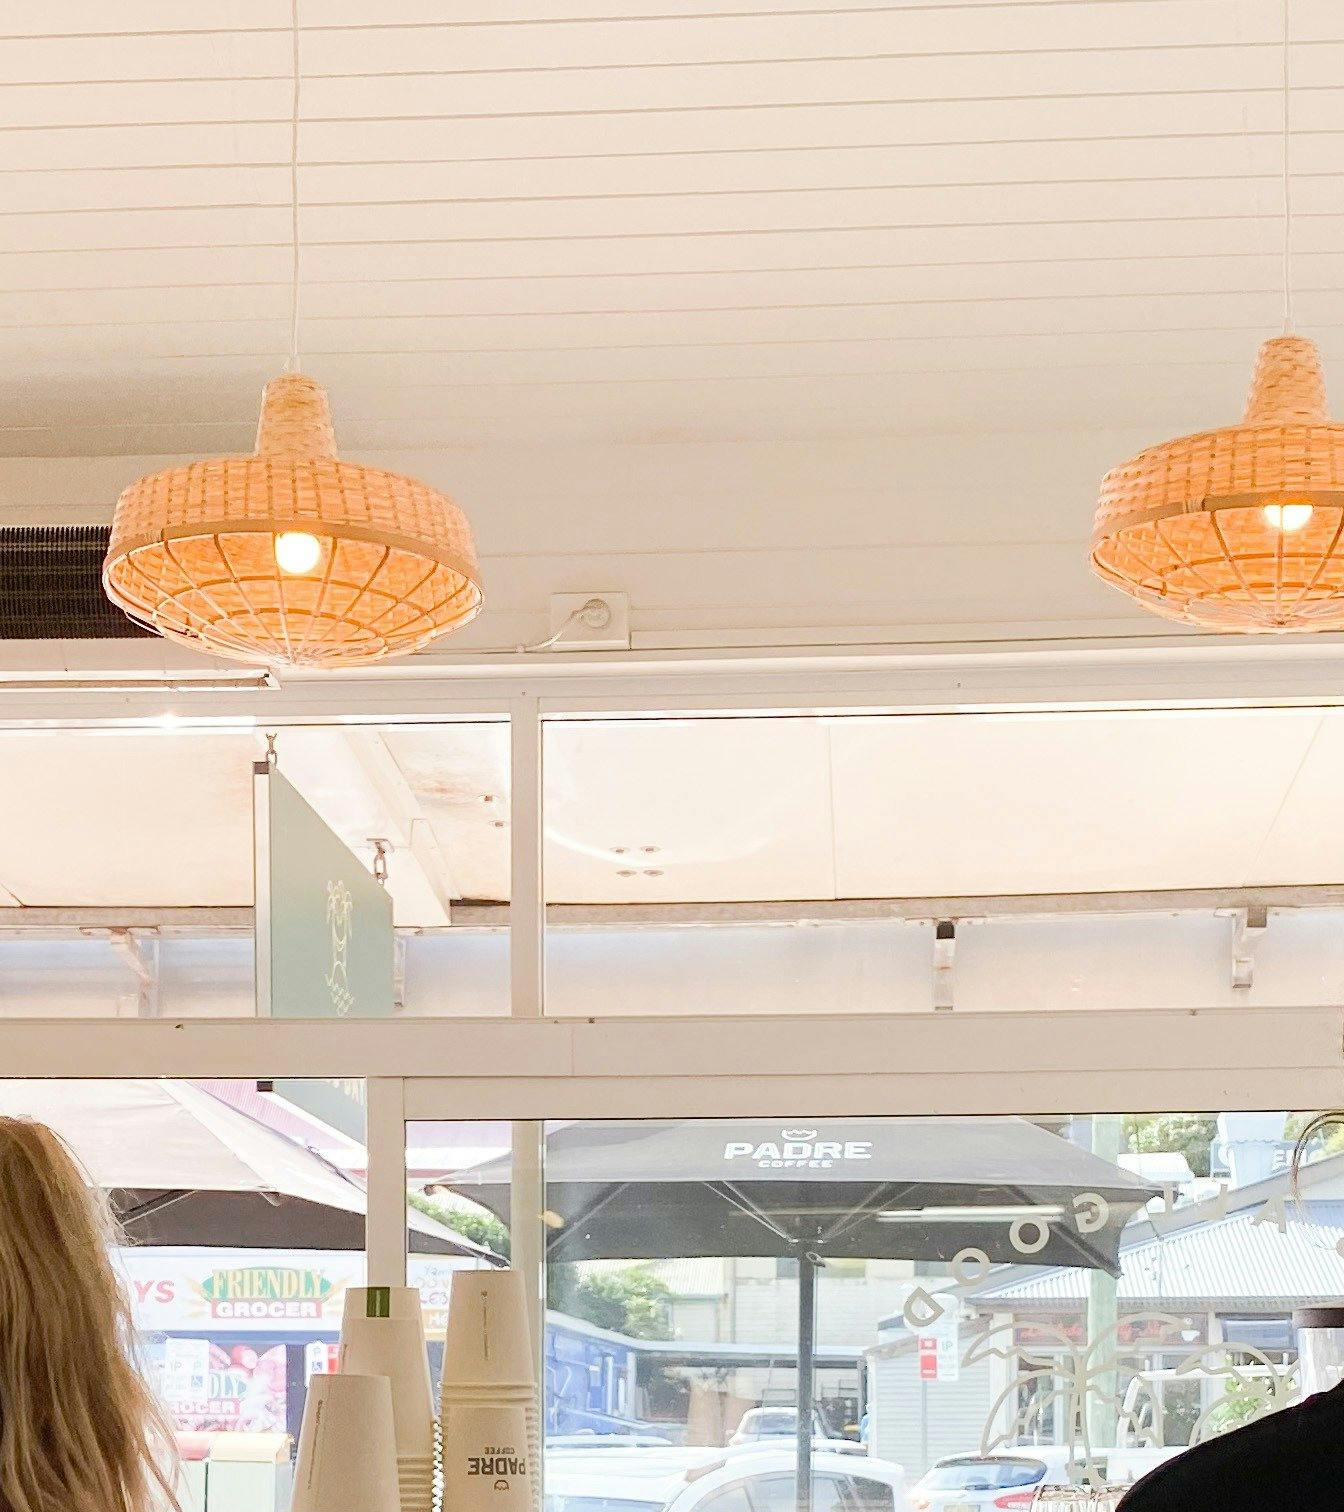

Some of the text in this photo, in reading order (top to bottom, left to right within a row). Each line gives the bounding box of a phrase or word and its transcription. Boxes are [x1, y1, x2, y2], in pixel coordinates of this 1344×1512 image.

[724, 1141, 873, 1160] PADRE
[759, 1159, 833, 1169] COFFEE
[212, 1269, 324, 1300] FRIENDLY
[216, 1301, 317, 1318] GROCER
[467, 1457, 526, 1475] PADRE
